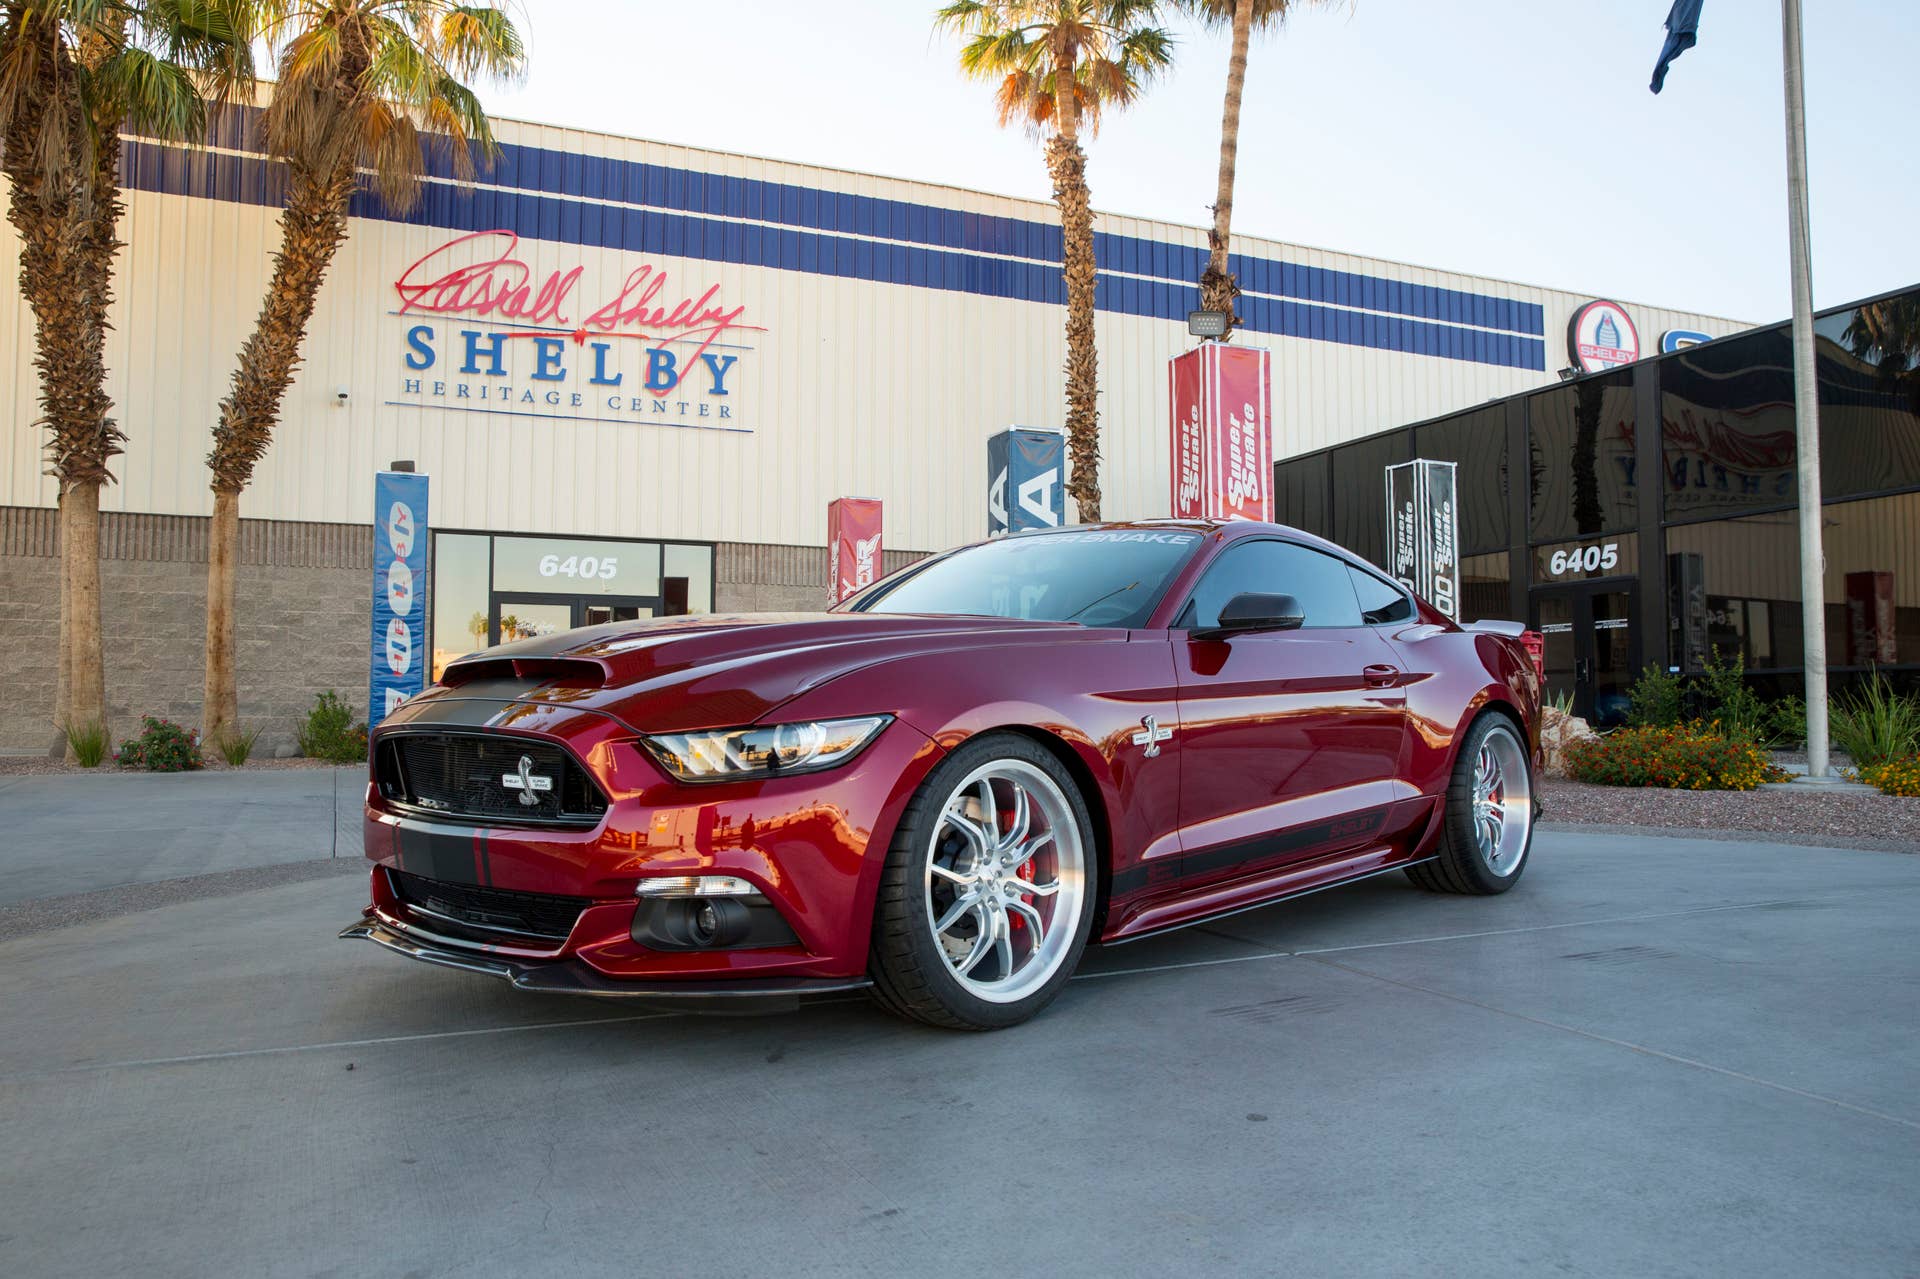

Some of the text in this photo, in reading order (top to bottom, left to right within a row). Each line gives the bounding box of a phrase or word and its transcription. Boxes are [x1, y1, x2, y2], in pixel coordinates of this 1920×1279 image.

[405, 325, 738, 396] SHELBY
[1580, 345, 1636, 364] SHELBY
[405, 378, 732, 419] HERITAGE CENTER
[1180, 419, 1190, 514] Super
[1189, 404, 1199, 502] Snake
[1228, 412, 1245, 511] Super
[1242, 402, 1258, 501] Snake
[539, 554, 618, 579] 6405
[1084, 532, 1196, 546] SNAKE
[1397, 510, 1406, 576] Super
[1404, 501, 1414, 568] Snake
[1434, 507, 1454, 620] 00 Super
[1442, 501, 1453, 568] Snake
[1550, 543, 1618, 575] 6405
